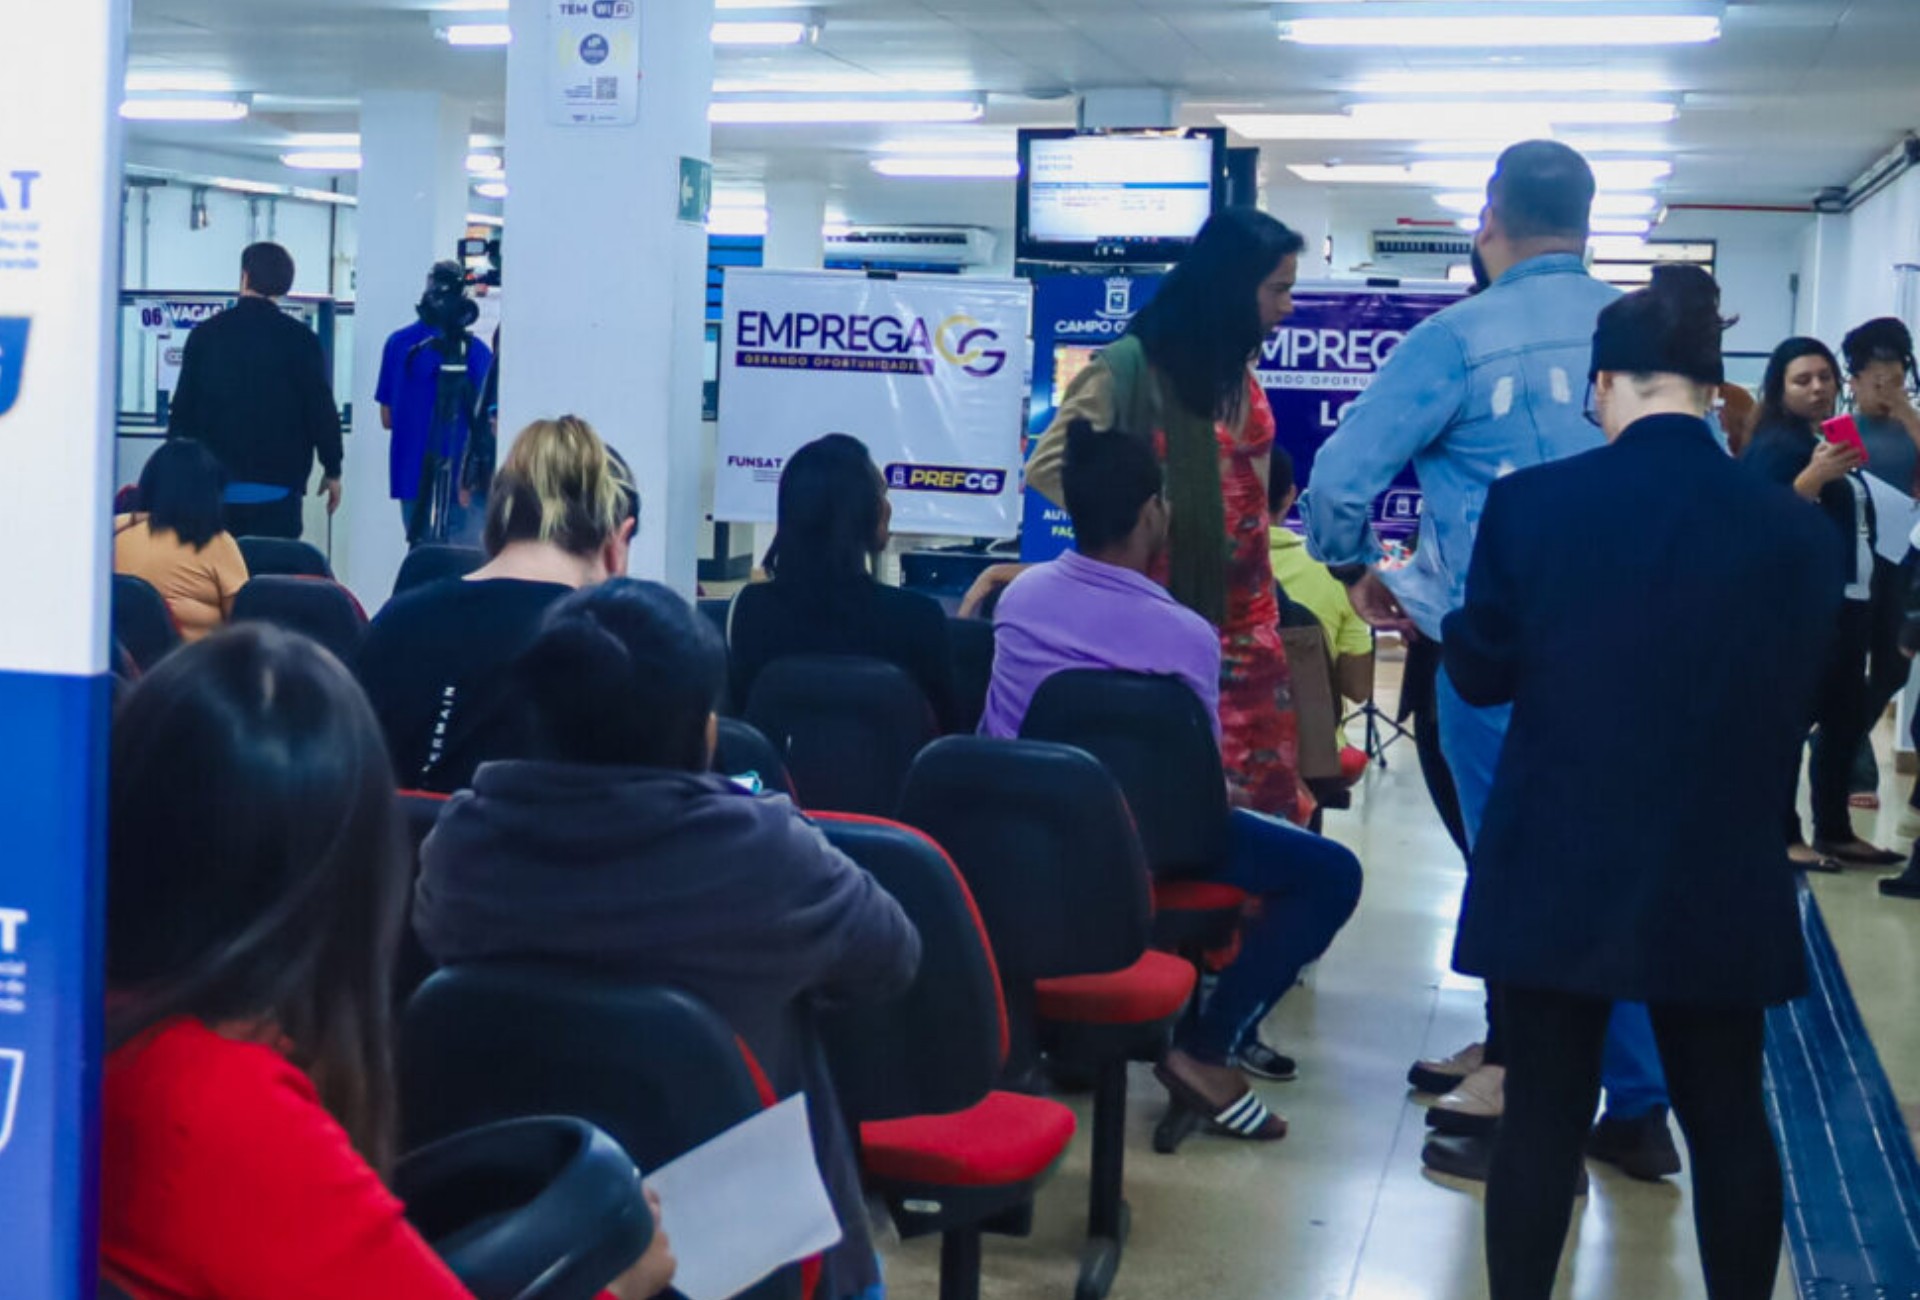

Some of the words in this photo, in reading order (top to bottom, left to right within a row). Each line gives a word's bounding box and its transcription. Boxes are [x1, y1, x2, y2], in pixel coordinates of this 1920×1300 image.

[0, 171, 41, 210] T
[142, 308, 162, 326] 06
[736, 311, 933, 354] EMPREGA
[1054, 320, 1112, 333] CAMPO
[744, 353, 808, 366] GERANDO
[728, 455, 782, 468] FUNSAT
[910, 469, 998, 490] PREFCG
